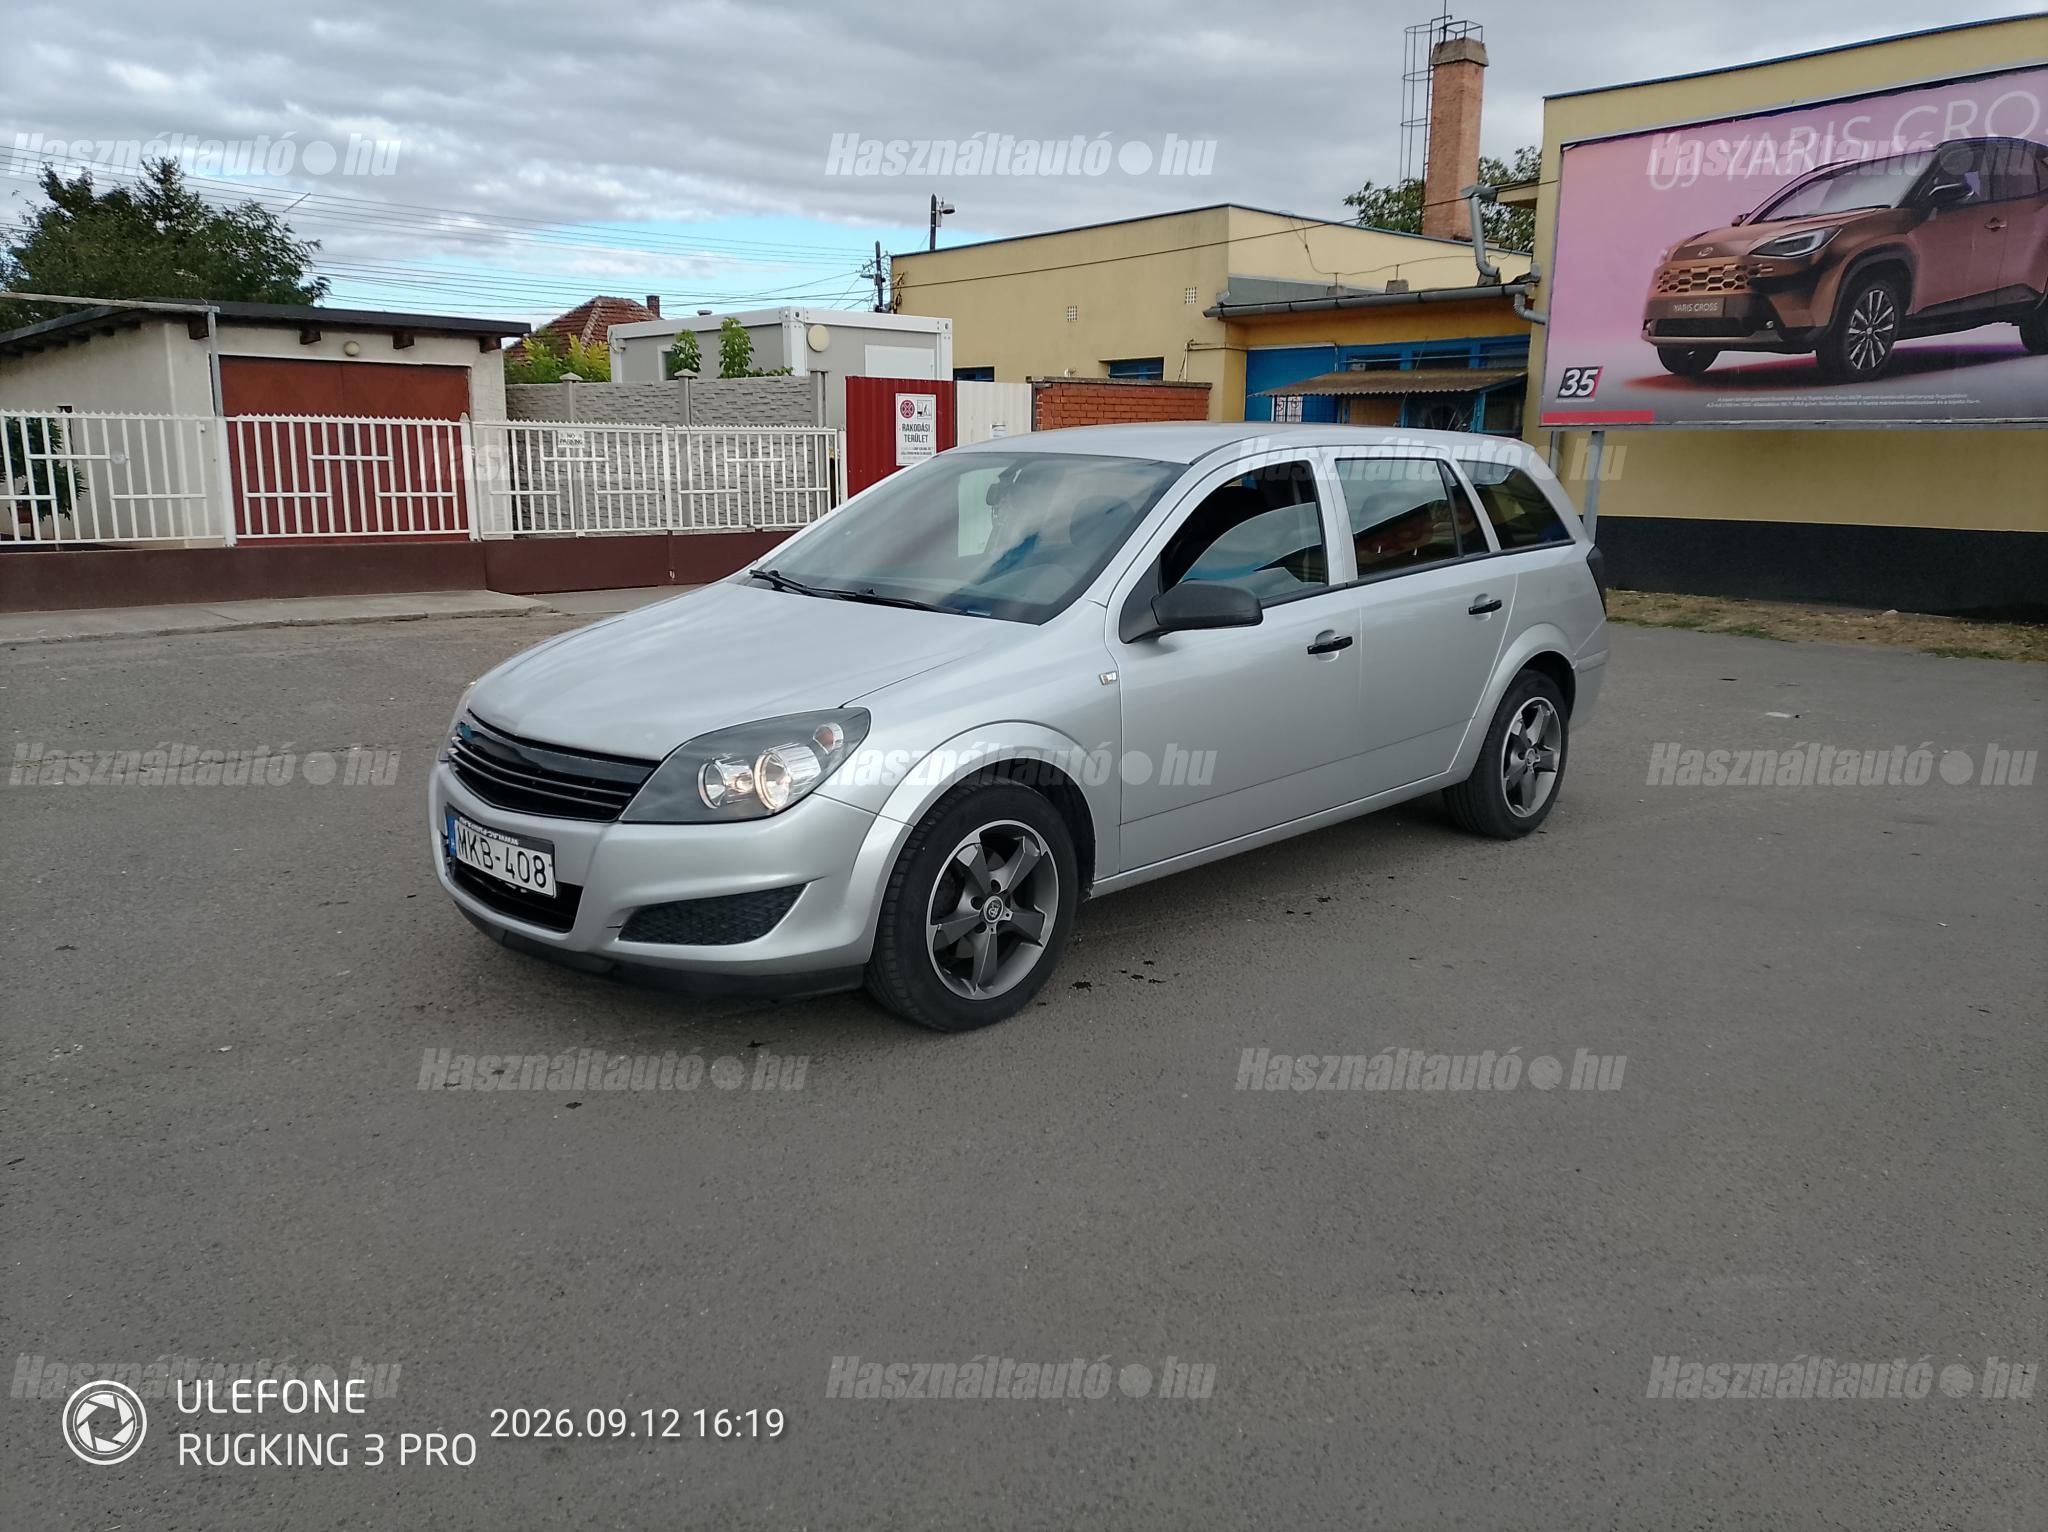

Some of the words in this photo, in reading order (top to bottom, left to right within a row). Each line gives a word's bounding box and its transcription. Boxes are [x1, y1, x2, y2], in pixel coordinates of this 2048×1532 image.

[1717, 116, 1871, 182] YARIS
[1893, 90, 2048, 151] CRO
[1694, 302, 1719, 312] CROSS
[1560, 368, 1599, 397] 35
[902, 423, 931, 432] RAKODÁSI
[904, 433, 928, 443] TERÜLET
[457, 825, 547, 888] MKB-408
